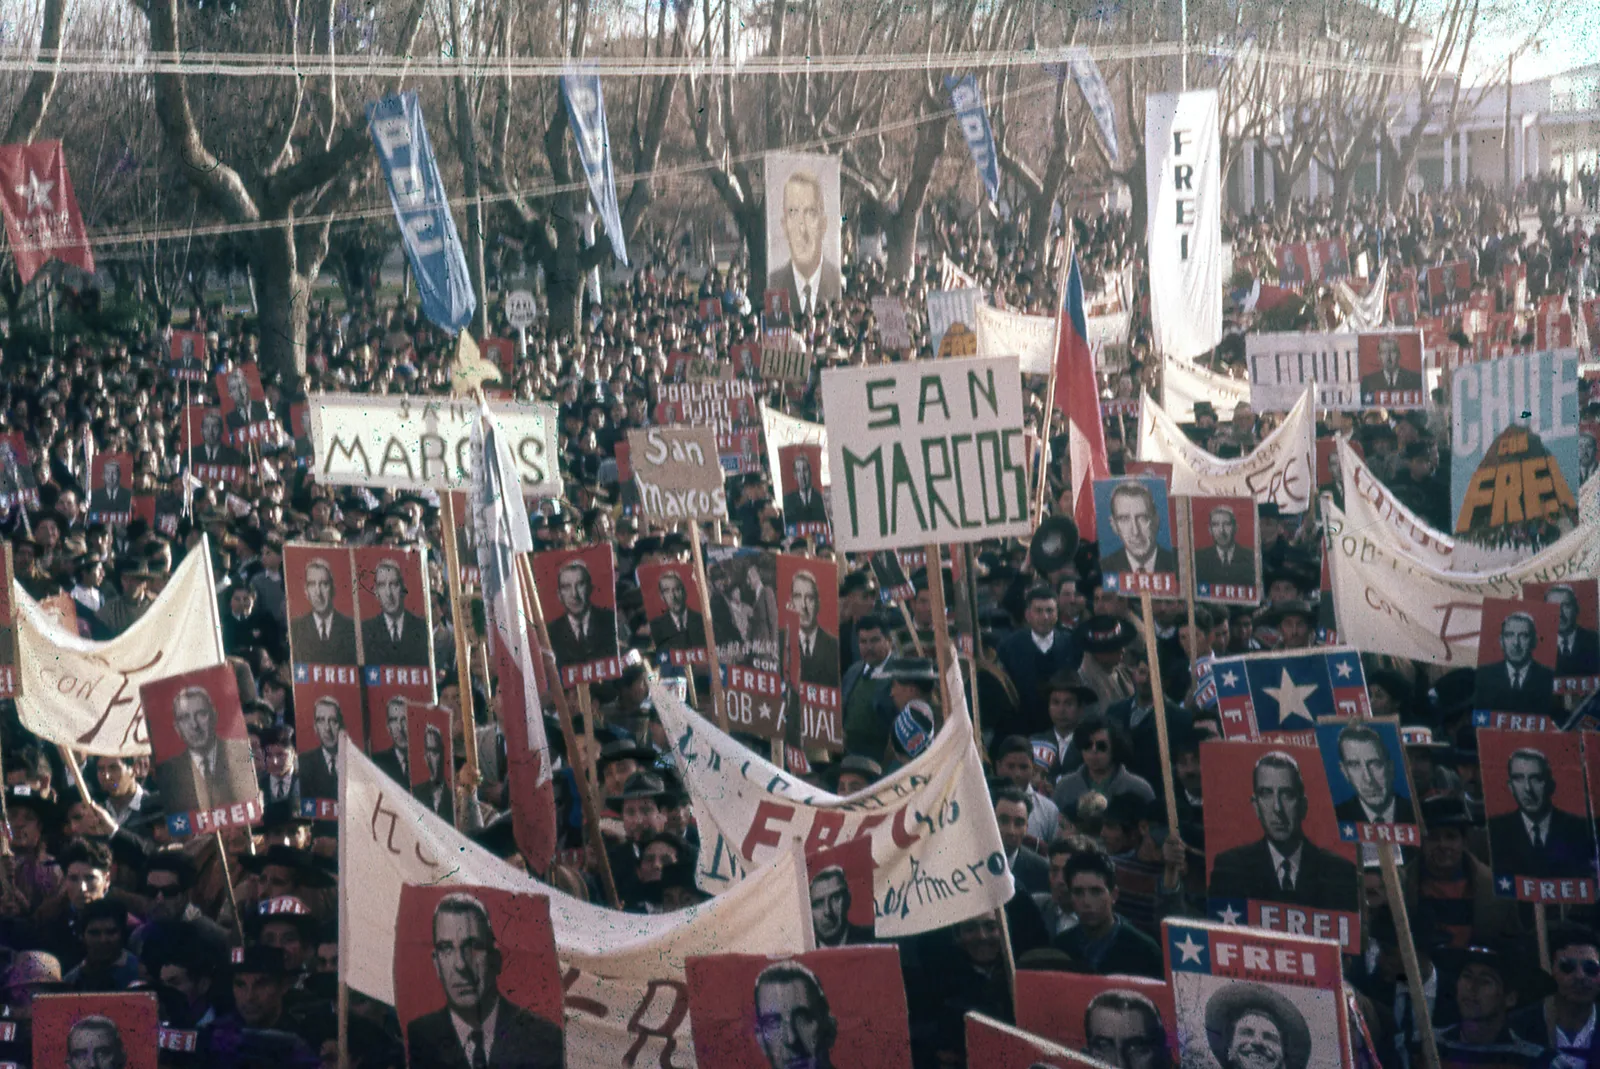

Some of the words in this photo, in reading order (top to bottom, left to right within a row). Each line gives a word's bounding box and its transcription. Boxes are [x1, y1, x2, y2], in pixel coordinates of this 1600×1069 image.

[1173, 129, 1196, 261] FREI
[866, 368, 999, 430] SAN
[1379, 391, 1419, 405] FREI
[1452, 352, 1579, 457] CHILE
[398, 402, 465, 423] SAN
[646, 428, 704, 466] San
[323, 434, 545, 486] MARCS
[198, 466, 236, 481] FREI
[841, 427, 1028, 538] MARCOS
[1455, 455, 1578, 533] FREI
[1125, 573, 1171, 591] FREI
[1214, 583, 1254, 598] FREI
[675, 650, 706, 664] FRE
[753, 657, 778, 674] CON
[312, 667, 356, 685] FREI
[385, 667, 429, 685] FREI
[568, 657, 616, 683] FREI
[731, 667, 776, 695] FREI
[1552, 676, 1600, 694] FREI
[1496, 713, 1546, 732] FREI
[196, 801, 254, 828] FREI
[1361, 825, 1415, 842] FREI
[1523, 879, 1588, 900] FREI
[1260, 905, 1349, 947] FREI
[1215, 942, 1317, 977] FREI
